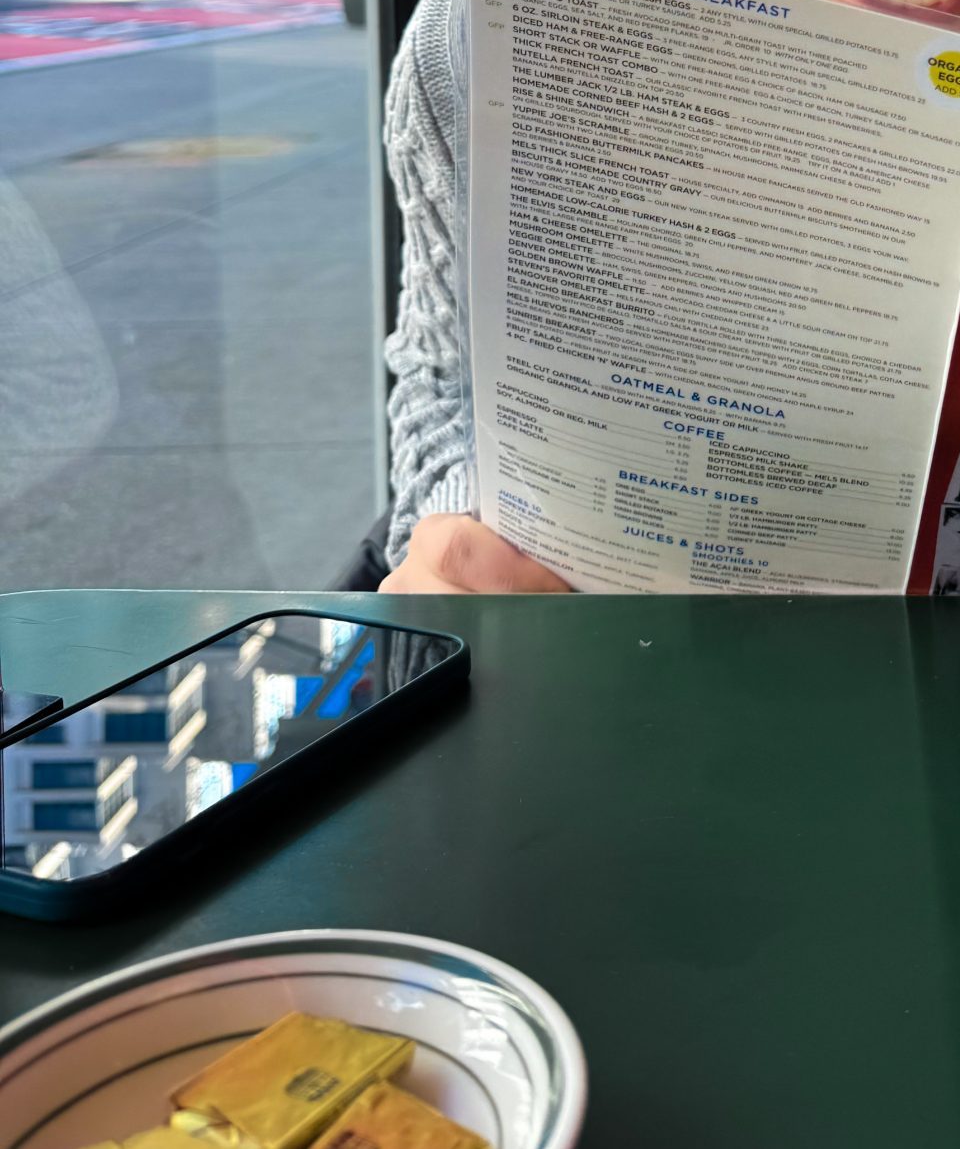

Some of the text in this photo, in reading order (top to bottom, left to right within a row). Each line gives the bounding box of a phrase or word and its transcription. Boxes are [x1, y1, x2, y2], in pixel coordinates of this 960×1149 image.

[512, 14, 543, 28] DICED
[546, 21, 568, 33] HAM
[580, 28, 643, 49] FREE-RANGE
[646, 42, 672, 55] EGGS
[521, 5, 537, 16] OZ.
[541, 9, 579, 25] SIRLOIN
[582, 18, 614, 32] STEAK
[626, 27, 652, 39] EGGS
[512, 25, 640, 59] SHORT STACK OR WAFFLE
[513, 36, 657, 73] THICK FRENCH TOAST COMBO
[512, 47, 632, 79] NUTELLA FRENCH TOAST
[512, 75, 569, 95] HOMEMADE
[572, 88, 612, 104] CORNED
[615, 97, 639, 110] BEEF
[642, 103, 668, 116] HASH
[688, 113, 713, 125] EGGS
[512, 86, 533, 98] RISE
[545, 93, 573, 106] SHINE
[576, 99, 629, 118] SANDWICH
[513, 65, 531, 76] THE
[534, 69, 573, 85] LUMBER
[576, 78, 601, 91] JACK
[604, 84, 617, 94] 1/2
[620, 87, 634, 98] LB.
[637, 91, 658, 103] HAM
[661, 96, 691, 110] STEAK
[704, 105, 729, 118] EGGS
[934, 83, 957, 96] ADD
[513, 104, 546, 118] YUPPIE
[578, 117, 629, 135] SCRAMBLE
[511, 139, 668, 179] MELS THICK SLICE FRENCH TOAST
[512, 121, 703, 169] OLD FASHIONED BUTTERMILK PANCAKES
[511, 166, 645, 202] NEW YORK STEAK AND EGGS
[510, 194, 607, 221] THE ELVIS SCRAMBLE
[509, 209, 530, 221] HAM
[541, 216, 576, 231] CHEESE
[579, 224, 627, 242] OMELETTE
[509, 229, 592, 254] VEGGIE OMELETTE
[508, 247, 622, 280] GOLDEN BROWN WAFFLE
[552, 266, 595, 283] FAVORITE
[597, 276, 644, 294] OMELETTE
[507, 275, 654, 316] EL RANCHO BREAKFAST BURRITO
[506, 363, 759, 432] ORGANIC GRANOLA AND LOW FAT GREEK YOGURT OR MILK
[611, 373, 784, 418] OATMEAL & GRANOLA
[663, 420, 724, 441] COFFEE
[708, 448, 808, 470] ESPRESSO MILK SHAKE
[709, 440, 790, 460] ICED CAPPUCCINO
[619, 469, 758, 505] BREAKFAST SIDES
[706, 471, 823, 495] BOTTOMLESS ICED COFFEE
[707, 456, 869, 487] BOTTOMLESS COFFEE MELS BLEND
[623, 525, 745, 555] JUICES & SHOTS
[692, 551, 768, 567] SMOOTHIES 10
